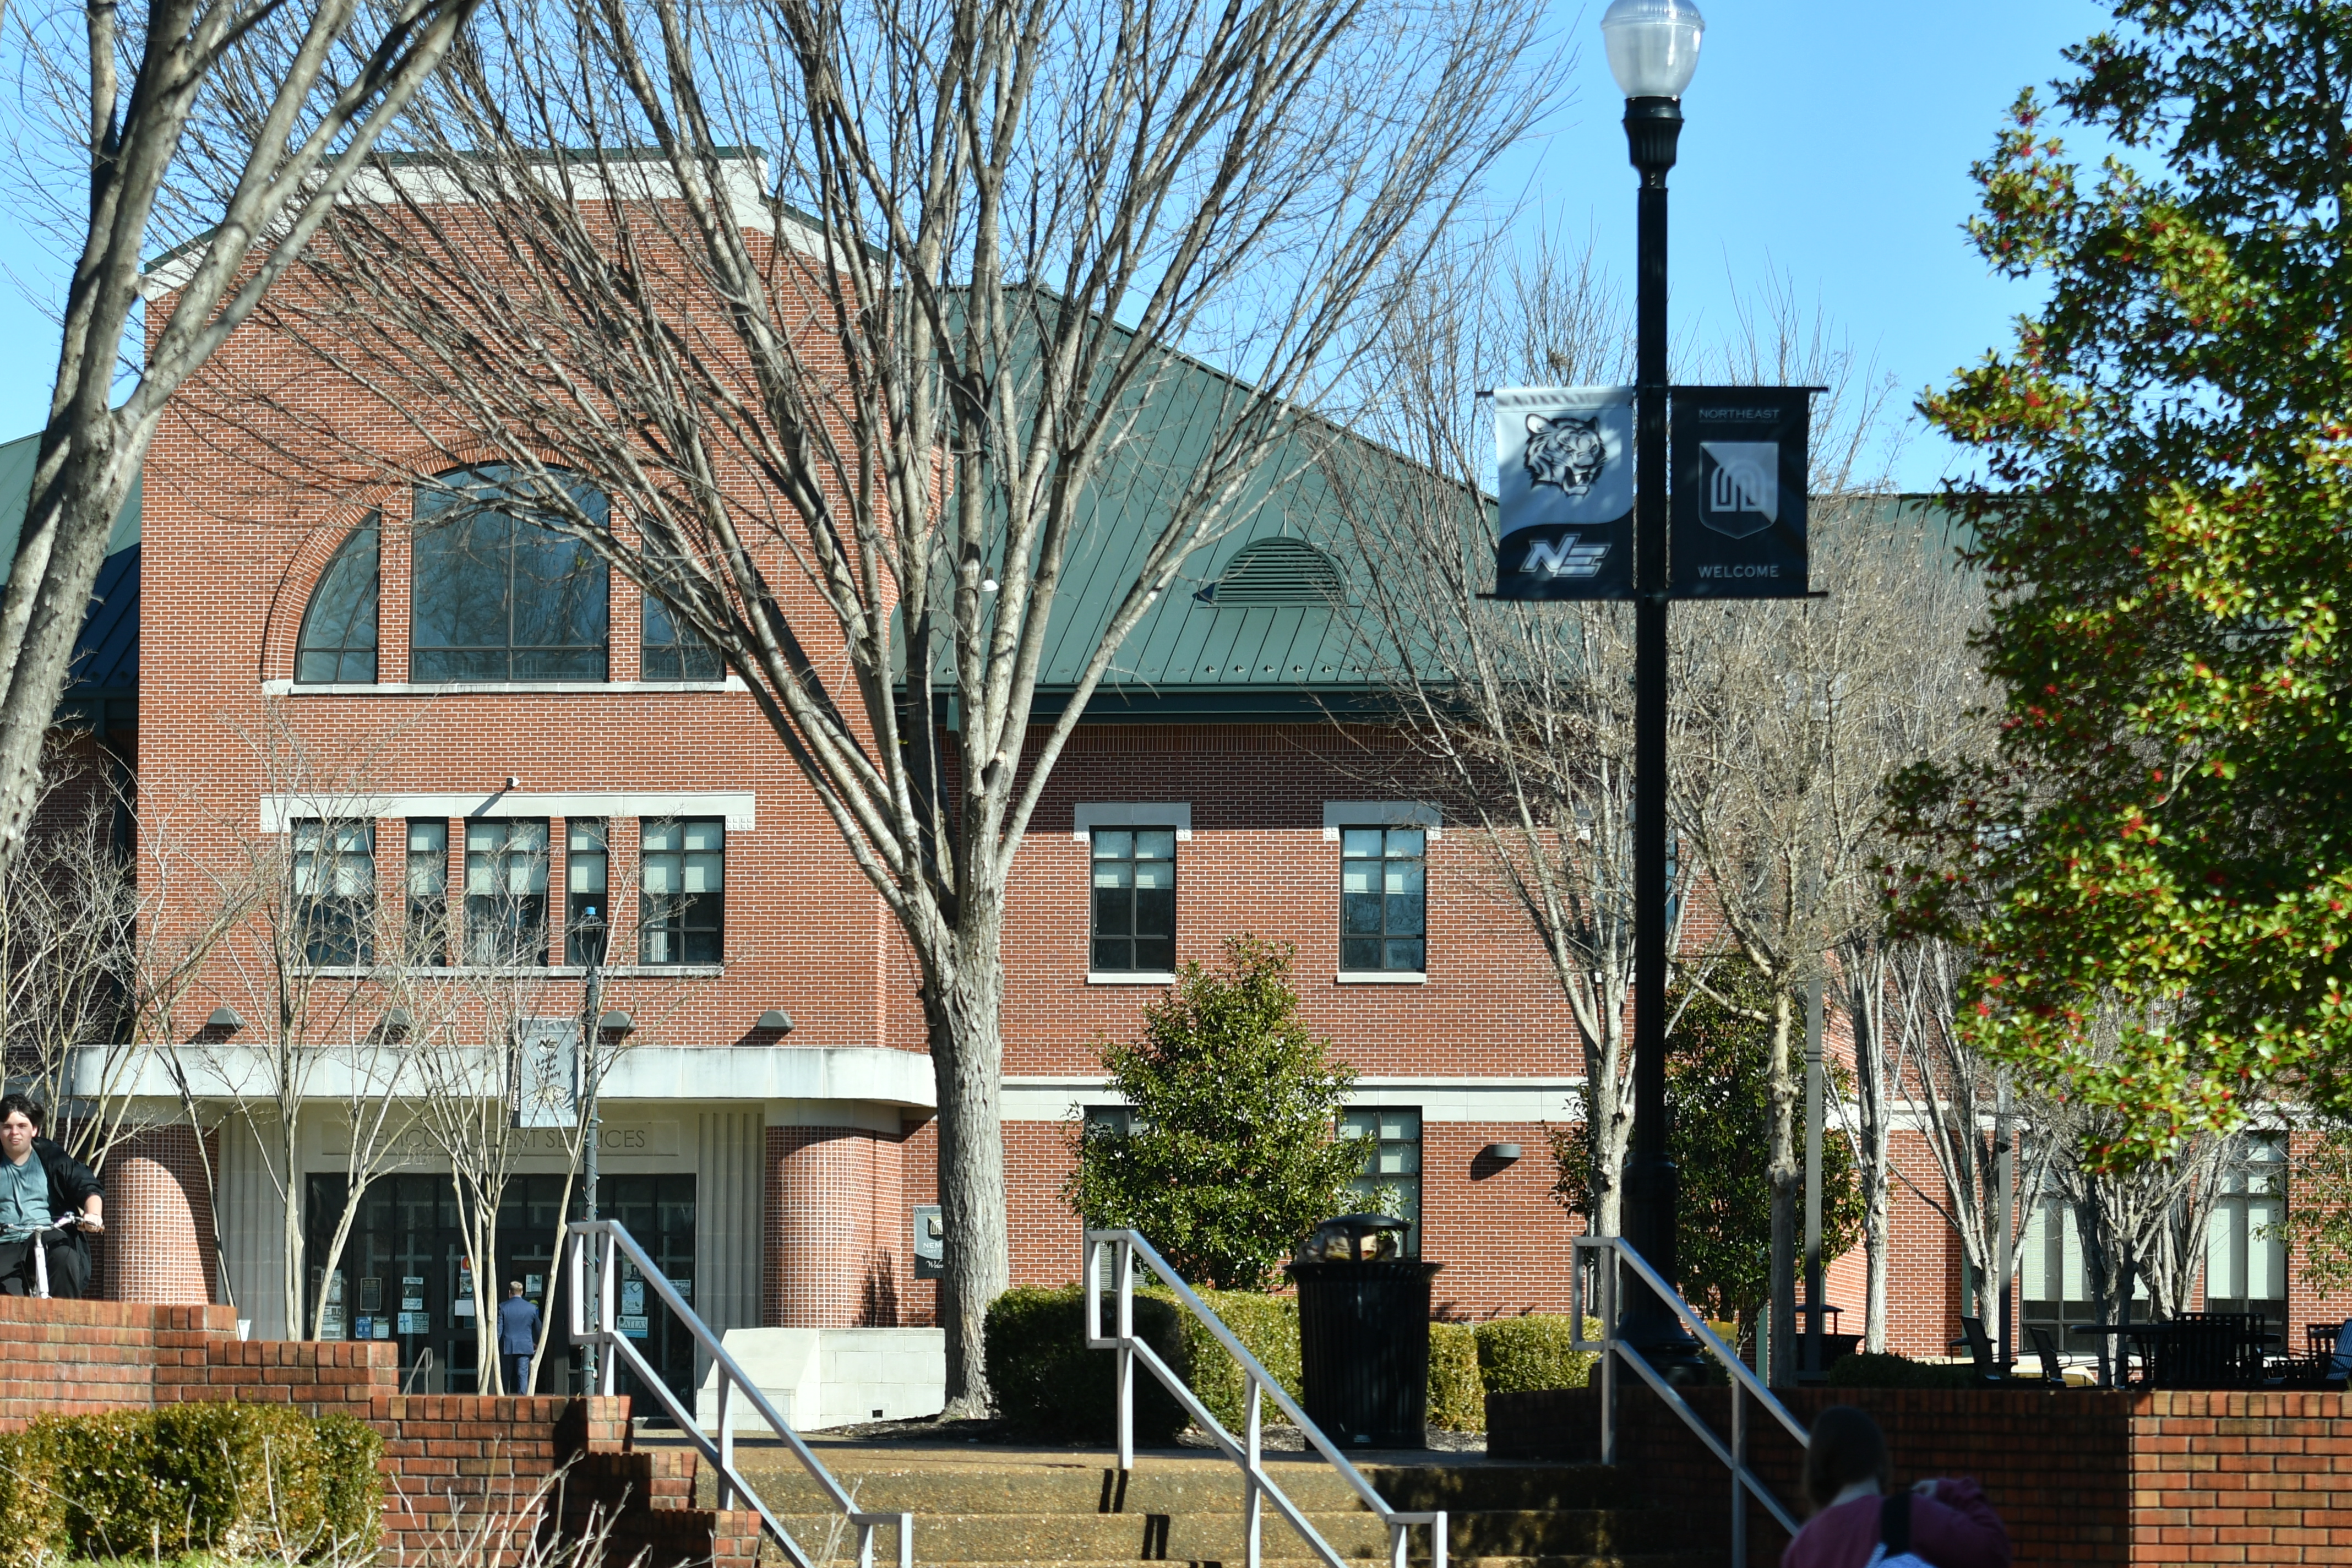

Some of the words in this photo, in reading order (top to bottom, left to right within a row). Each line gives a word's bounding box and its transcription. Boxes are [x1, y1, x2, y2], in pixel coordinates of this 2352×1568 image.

[1698, 409, 1779, 419] NORTHEAST
[1698, 565, 1779, 579] WELCOME
[449, 1129, 539, 1148] SUDENT
[545, 1129, 645, 1148] SERICES
[925, 1260, 944, 1268] Welco
